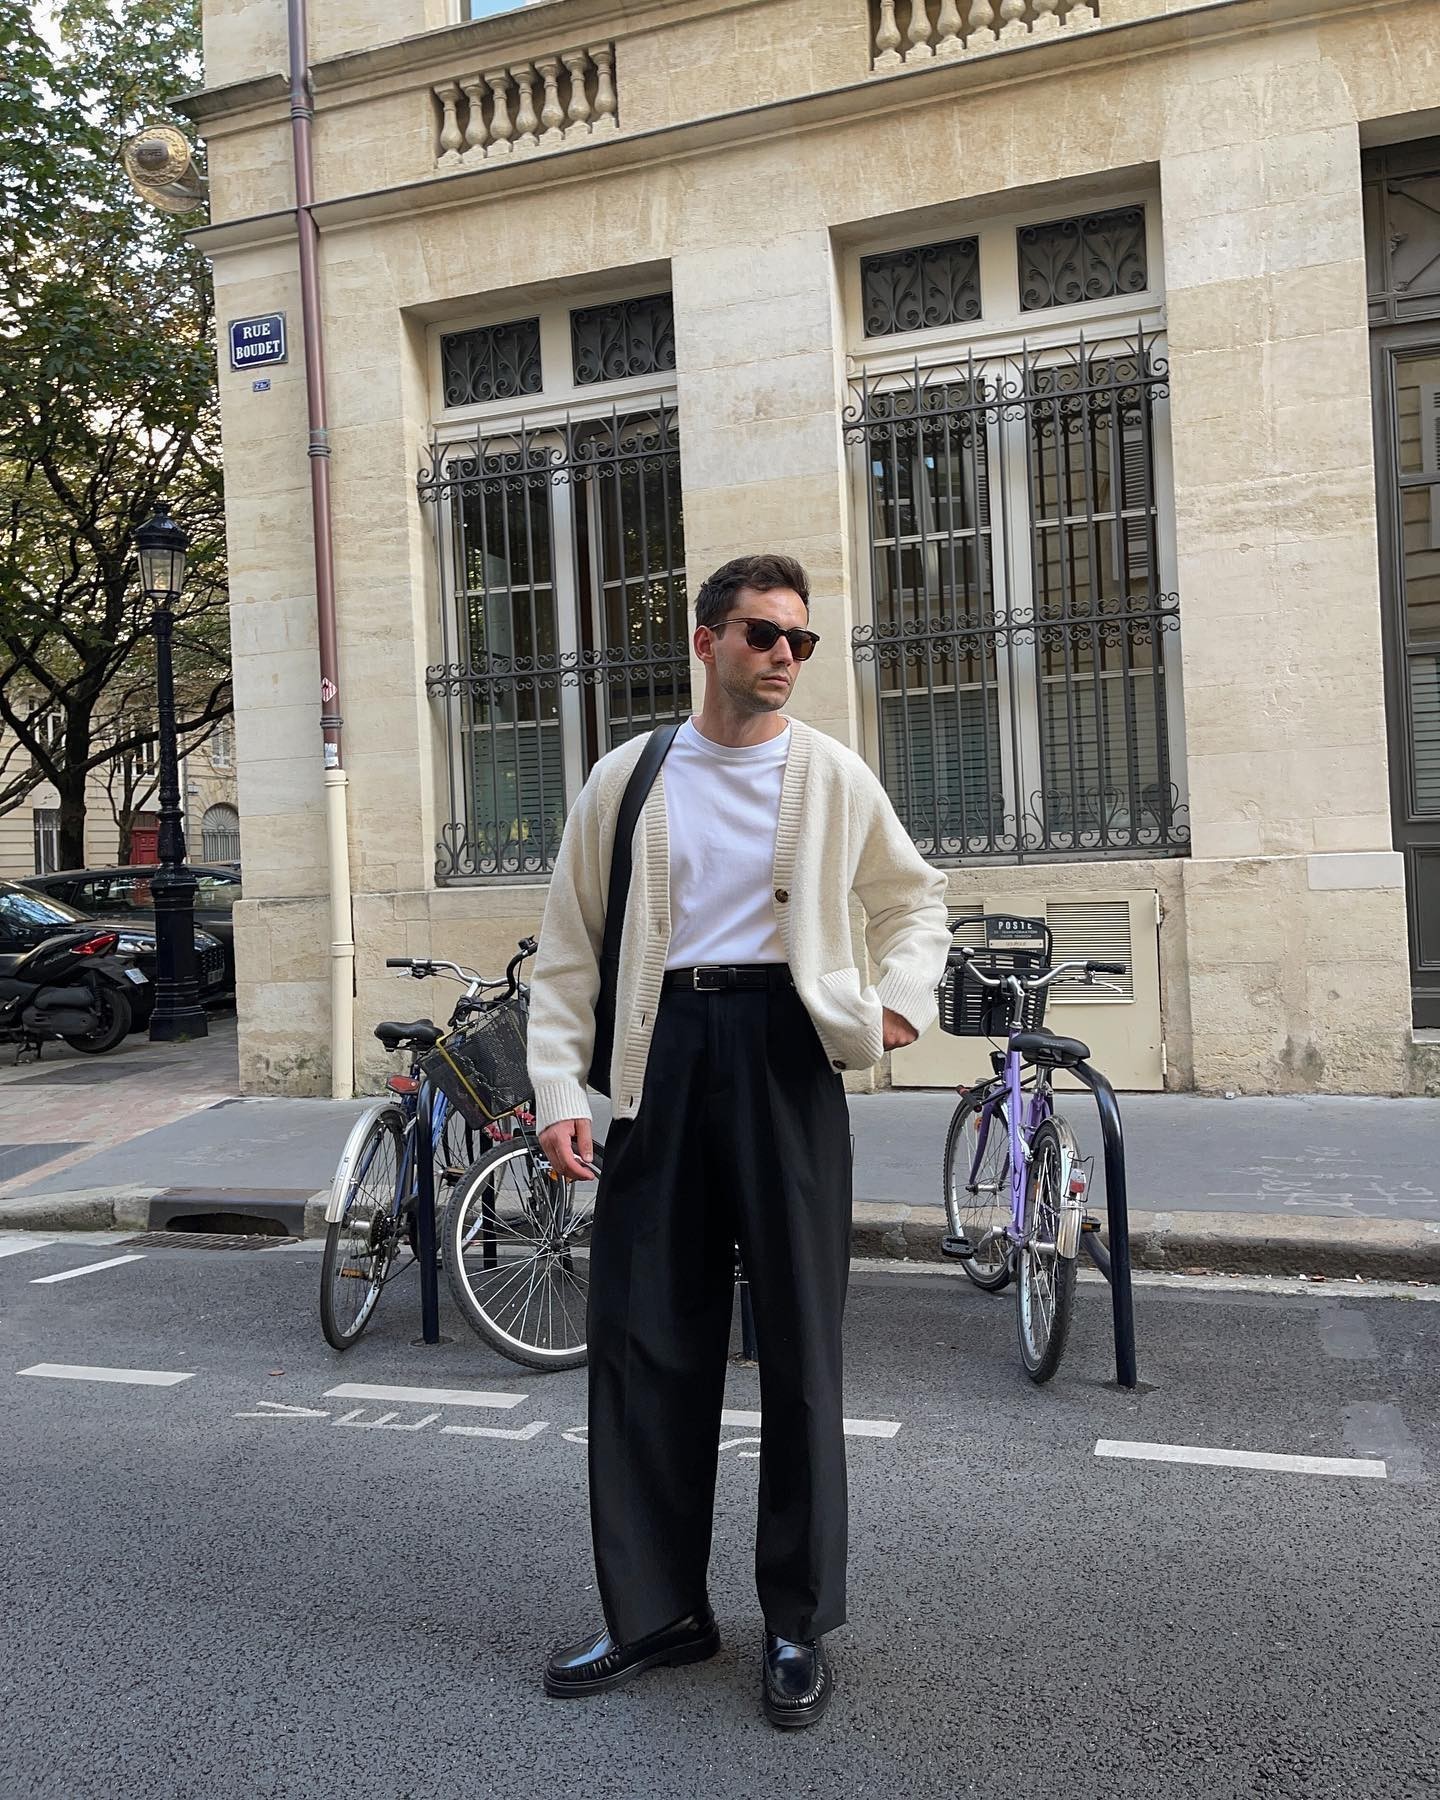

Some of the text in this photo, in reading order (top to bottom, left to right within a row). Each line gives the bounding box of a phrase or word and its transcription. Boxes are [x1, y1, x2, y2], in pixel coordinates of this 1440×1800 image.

[243, 323, 271, 339] RUE
[236, 340, 280, 360] BOUDET
[998, 921, 1033, 930] POSTE
